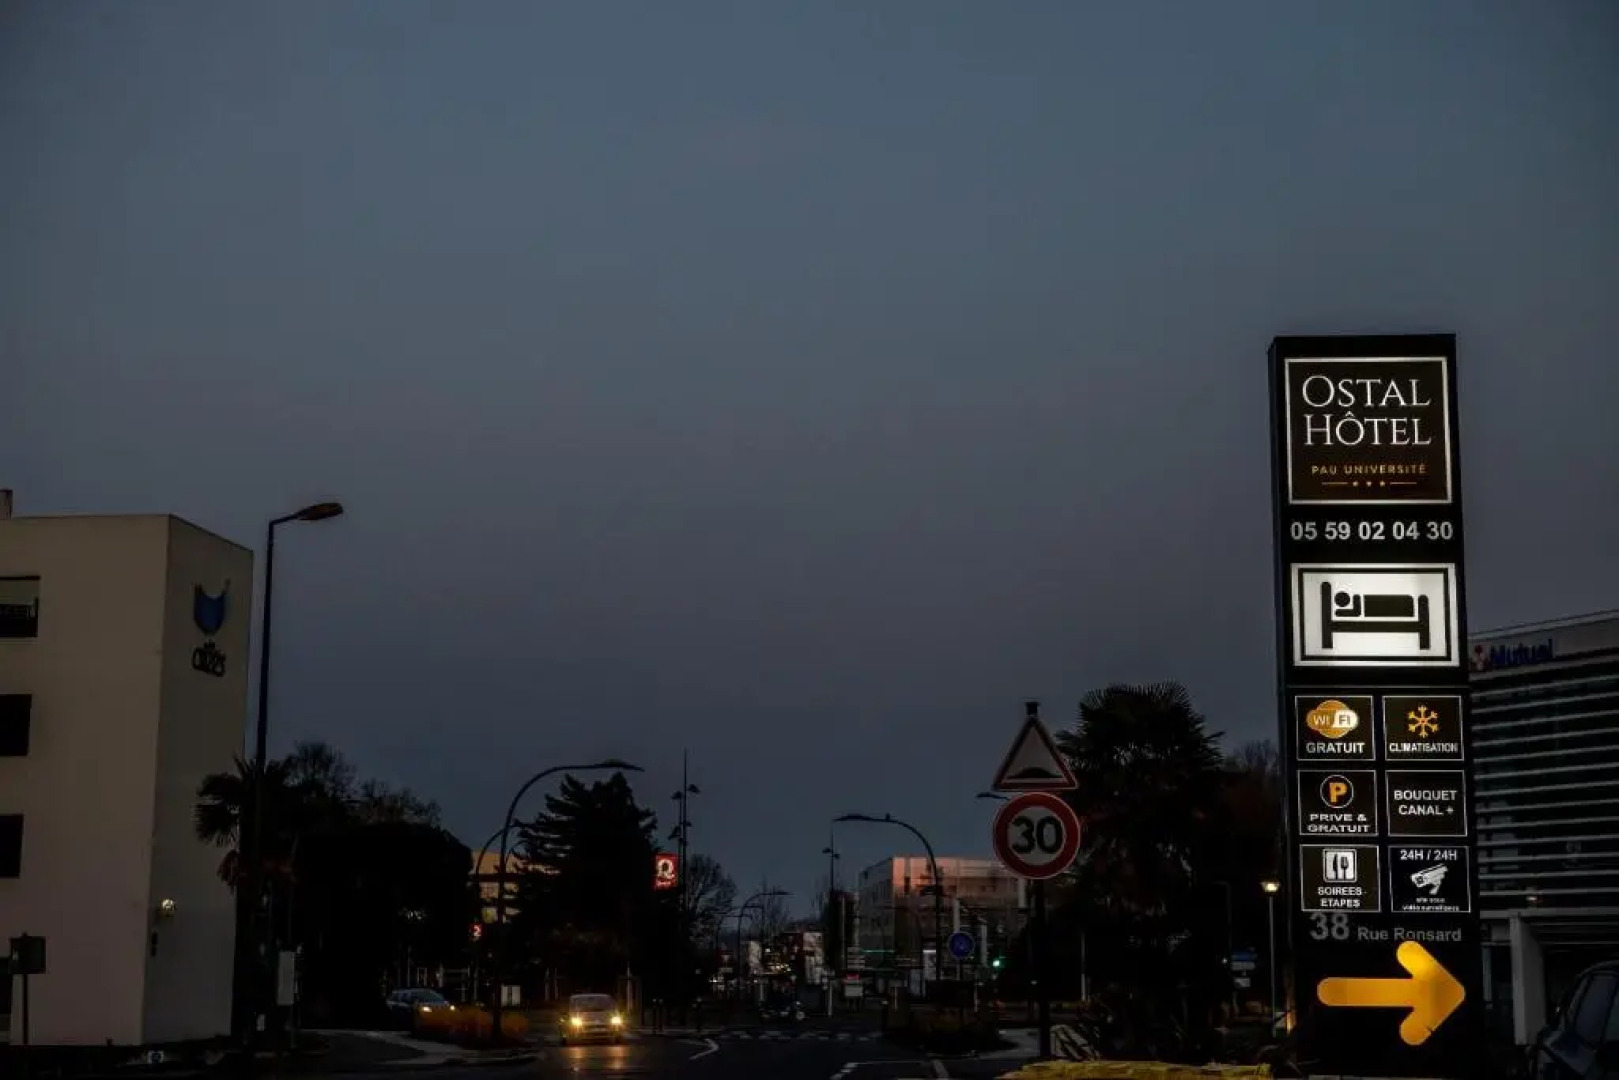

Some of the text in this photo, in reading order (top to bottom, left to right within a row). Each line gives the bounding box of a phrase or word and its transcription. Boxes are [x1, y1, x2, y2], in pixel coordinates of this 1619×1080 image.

[1303, 410, 1432, 446] HÔTEL
[1311, 462, 1427, 475] PAU UNIVERSITÉ
[1290, 521, 1453, 541] 05 59 02 04 30
[1305, 742, 1365, 753] GRATUIT
[1389, 742, 1459, 753] CLIMATISATION
[1328, 782, 1348, 803] P
[1394, 790, 1457, 801] BOUQUET
[1398, 804, 1443, 815] CANAL
[1310, 813, 1367, 822] PRIVE &
[1307, 824, 1370, 833] GRATUIT
[1011, 816, 1062, 853] 30
[1400, 850, 1424, 861] 24H
[1434, 850, 1458, 861] 24H
[1317, 886, 1362, 896] SOIREES
[1320, 897, 1361, 908] ETAPES
[1309, 911, 1350, 941] 38
[1357, 926, 1462, 942] Rue Ronsard
